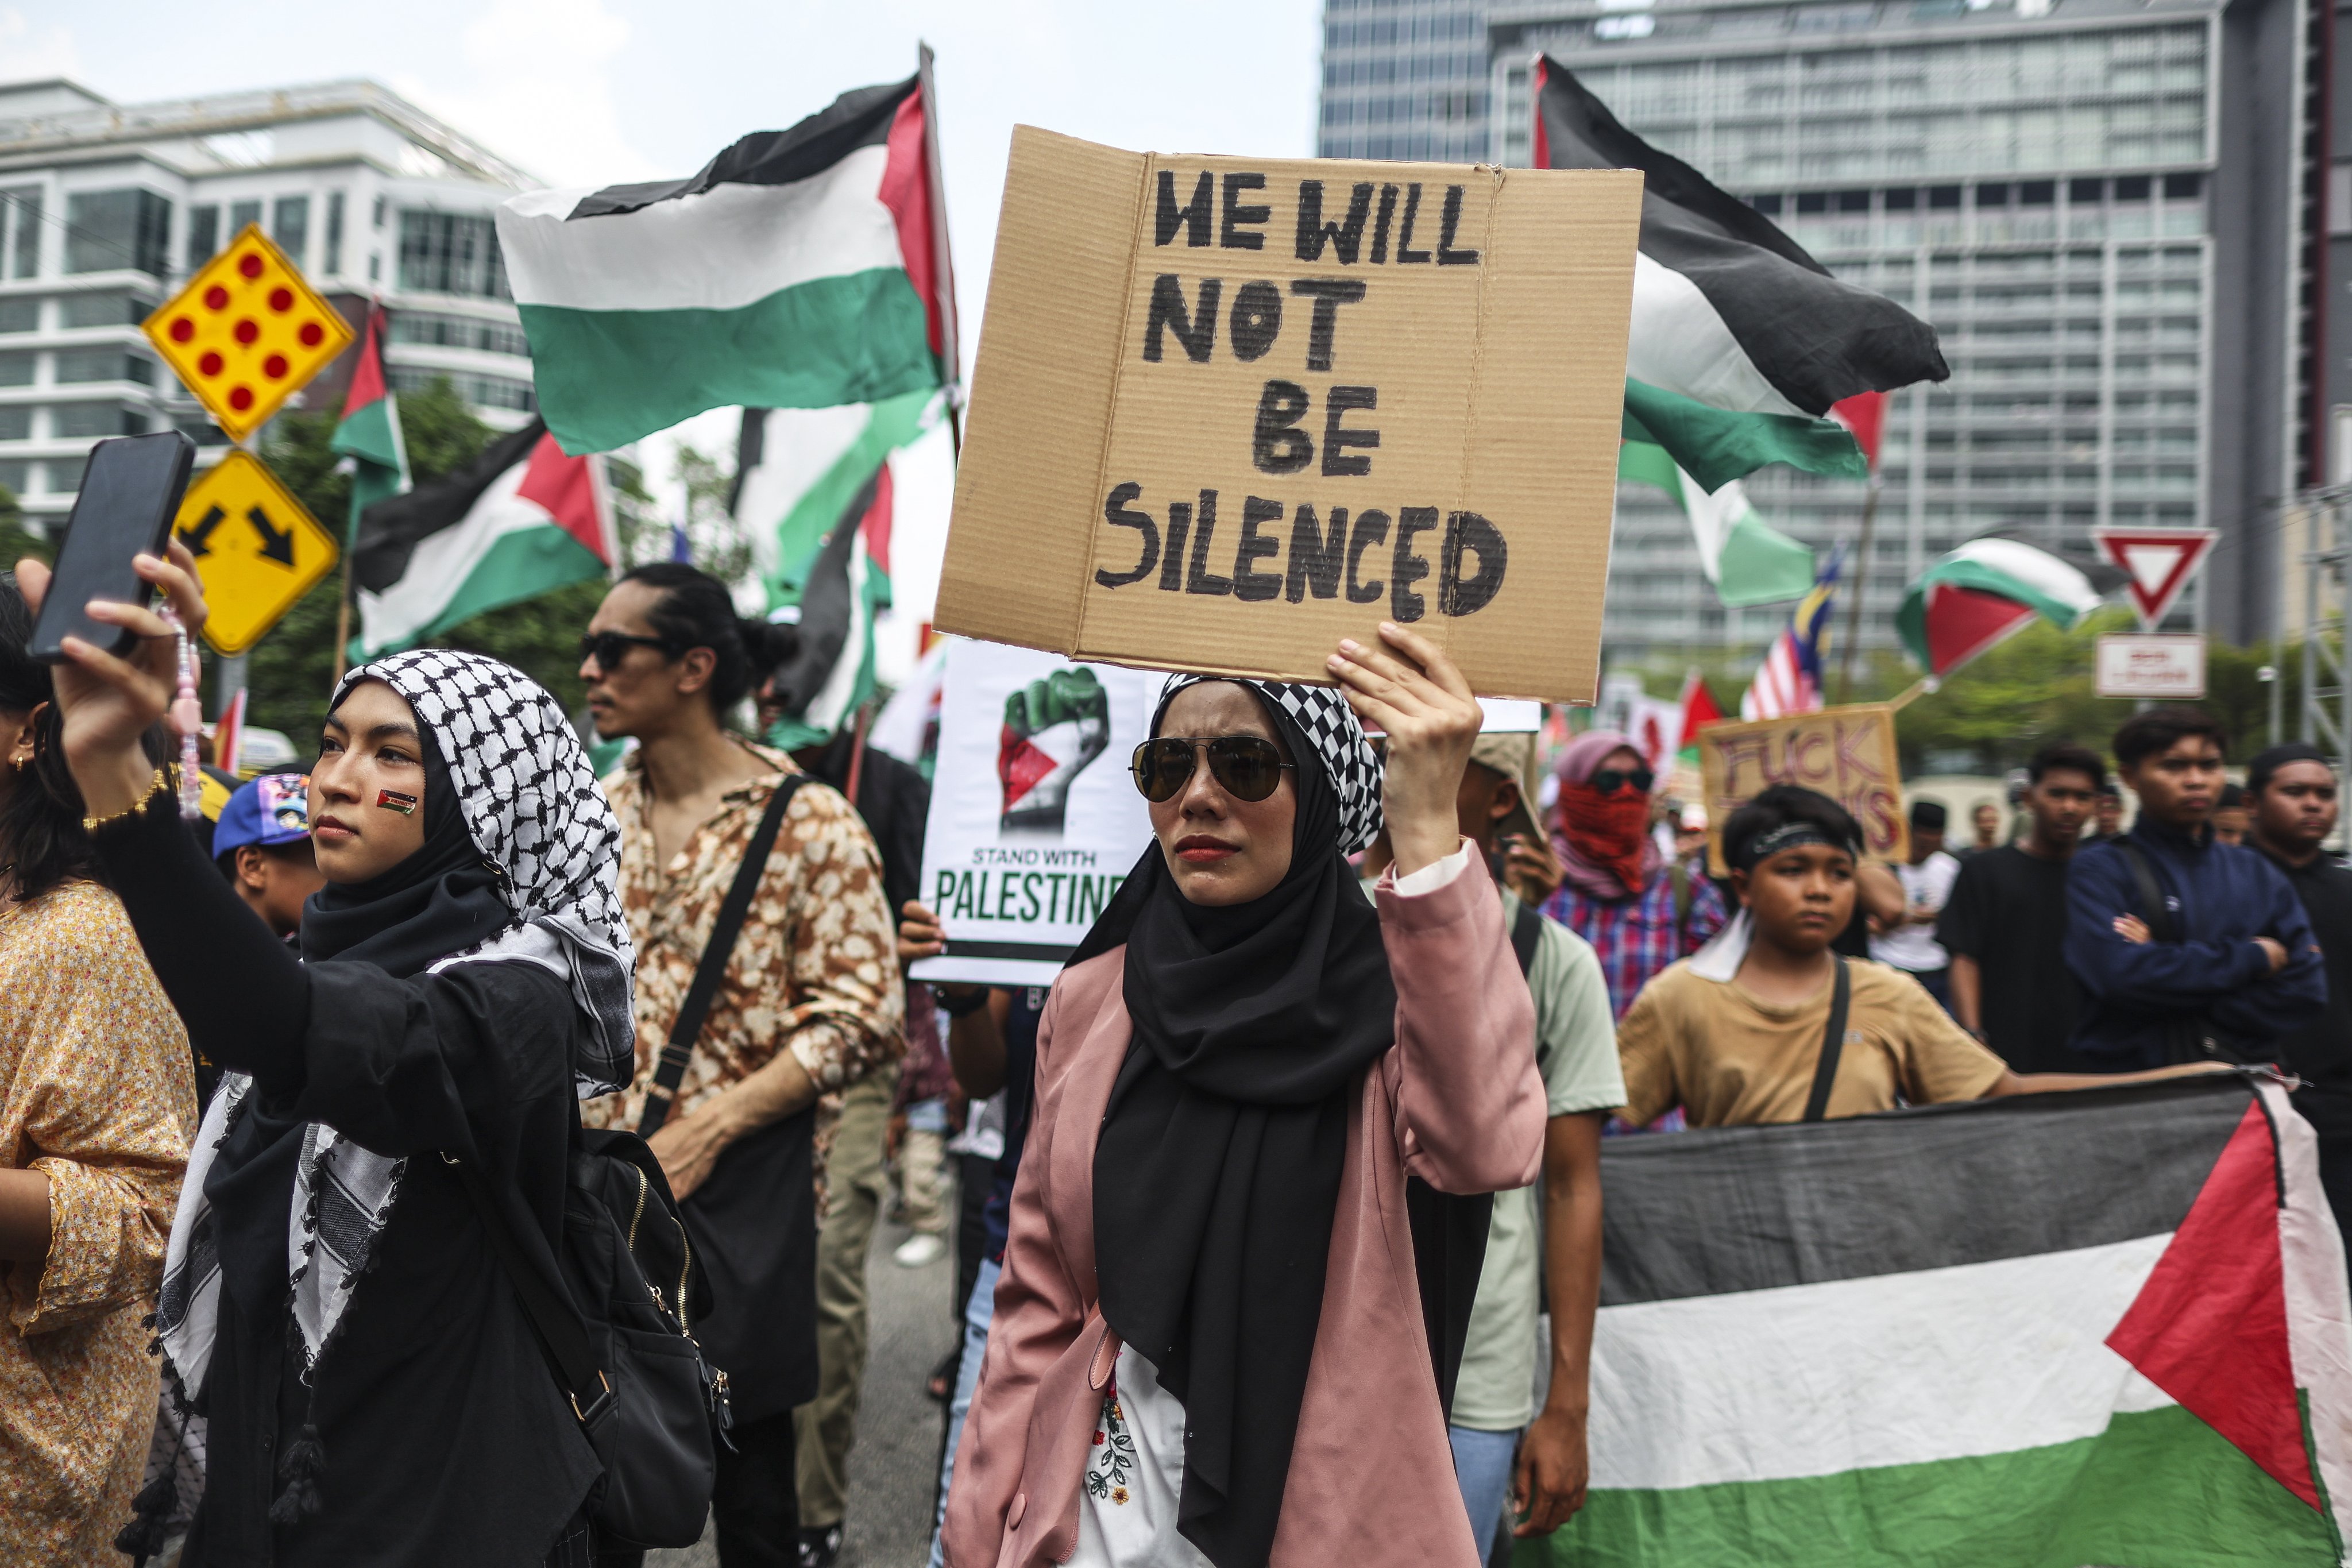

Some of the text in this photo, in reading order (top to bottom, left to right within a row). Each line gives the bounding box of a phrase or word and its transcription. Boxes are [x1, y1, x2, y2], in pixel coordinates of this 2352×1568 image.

[1154, 169, 1480, 266] WE WILL
[1142, 273, 1367, 372] NOT
[1253, 380, 1380, 477] BE
[1094, 481, 1508, 623] SILENCED
[1712, 718, 1887, 794] FUCK
[972, 847, 1097, 867] STAND WITH
